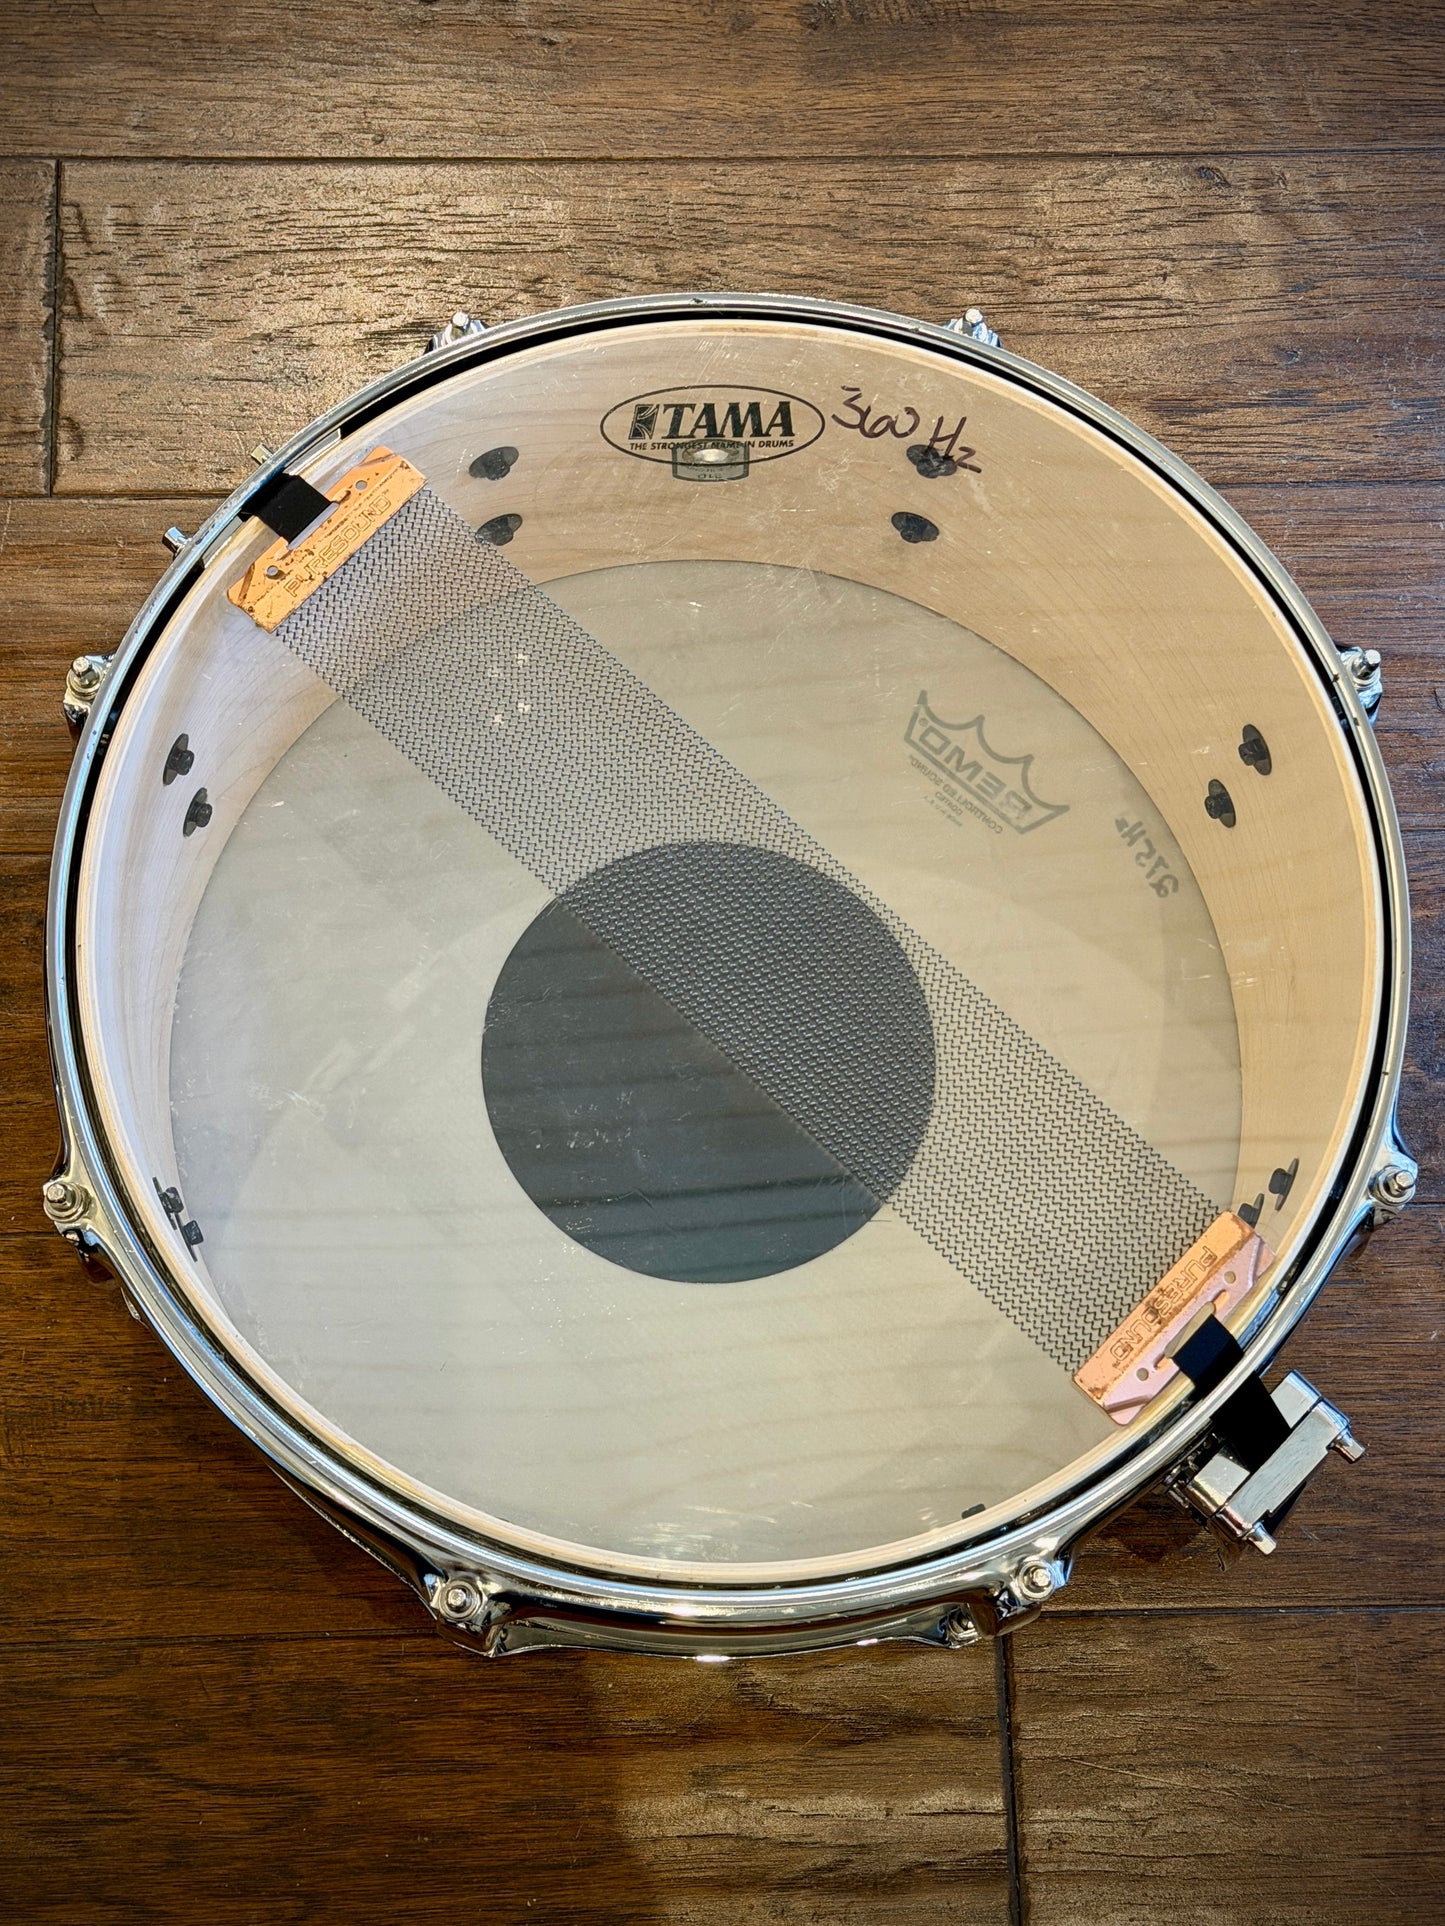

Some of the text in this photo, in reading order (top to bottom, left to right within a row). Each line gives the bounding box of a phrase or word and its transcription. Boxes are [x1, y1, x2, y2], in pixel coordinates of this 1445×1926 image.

[660, 401, 796, 440] TAMA
[831, 385, 920, 438] 360
[629, 439, 794, 451] THE STRONGEST NAME IN DRUMS
[283, 495, 392, 597] PURESOUND
[1110, 1245, 1218, 1361] PURESOUND
